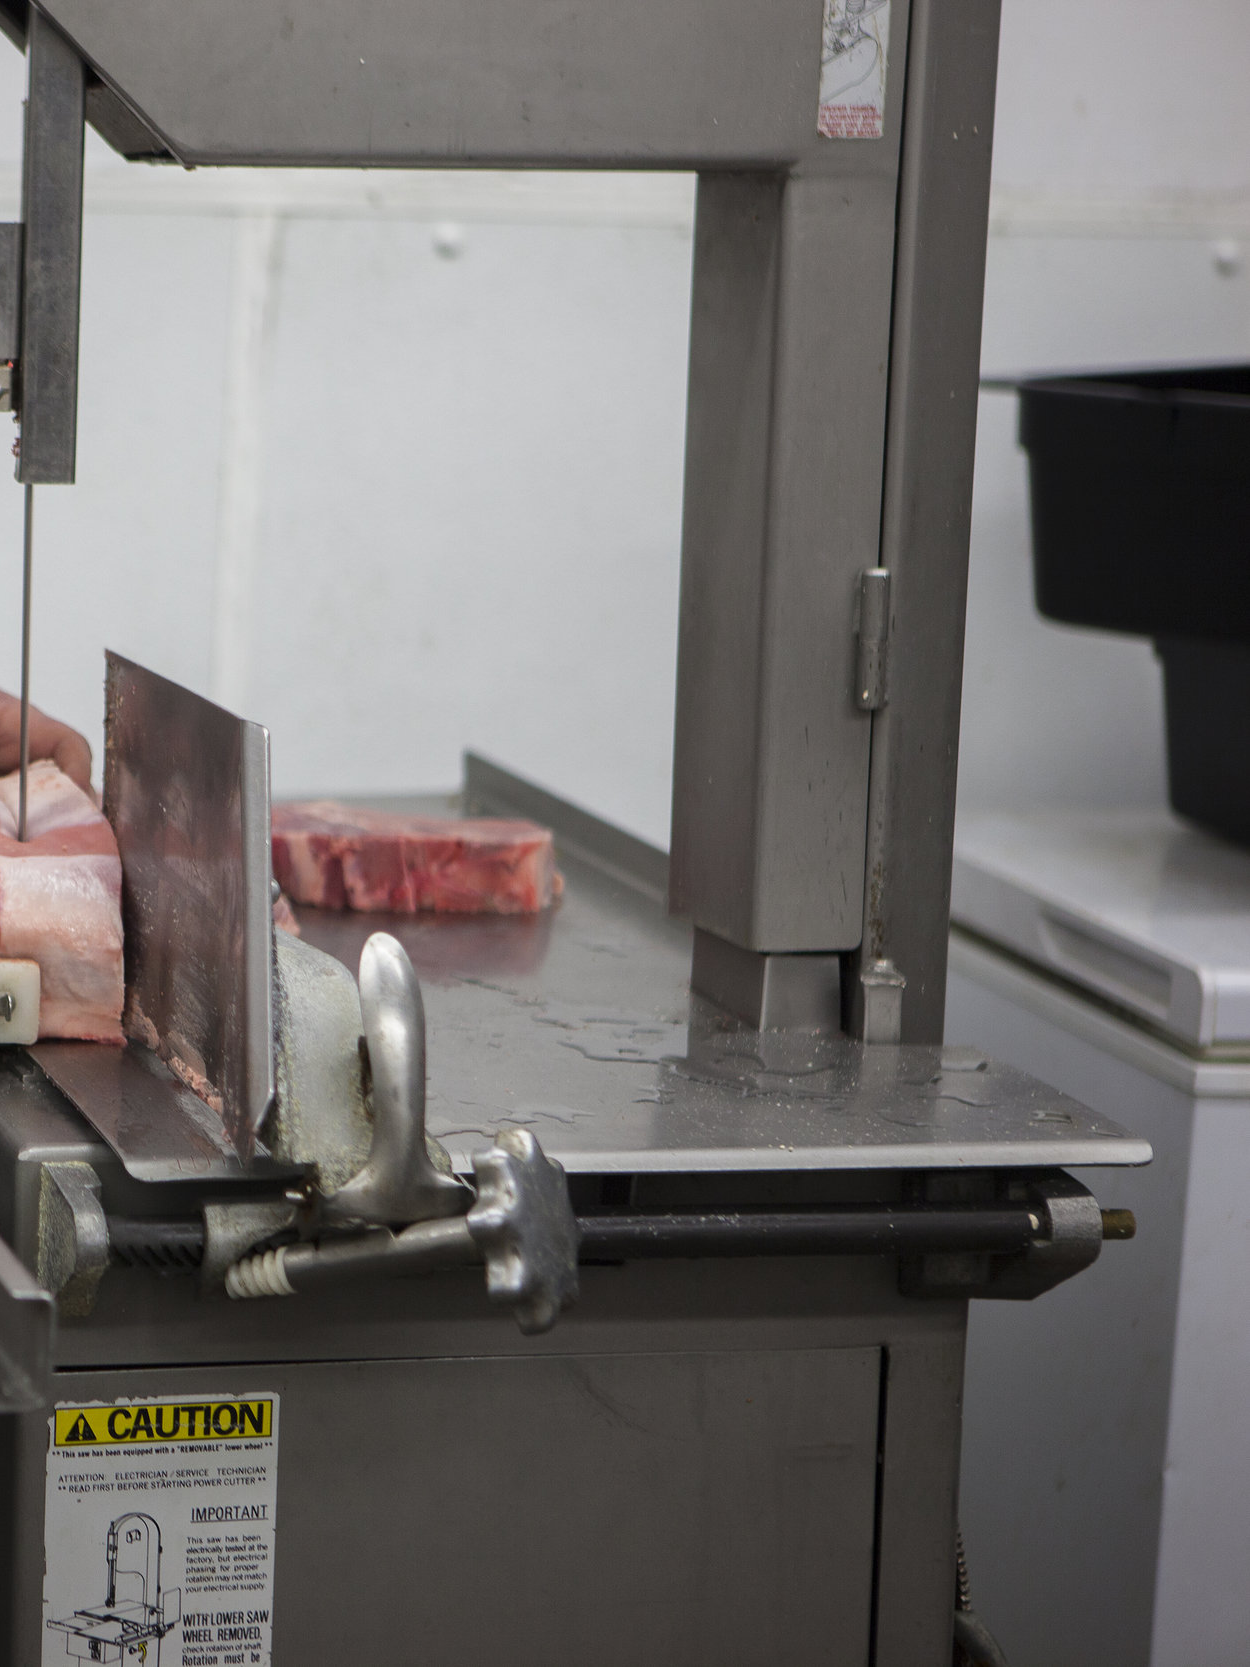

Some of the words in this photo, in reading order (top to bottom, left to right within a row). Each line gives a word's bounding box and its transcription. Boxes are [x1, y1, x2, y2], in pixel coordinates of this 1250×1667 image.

[108, 1403, 264, 1439] CAUTION
[62, 1450, 75, 1458] This
[105, 1448, 121, 1456] been
[123, 1447, 153, 1457] equipped
[155, 1446, 169, 1454] with
[245, 1442, 263, 1450] wheel
[115, 1470, 168, 1480] ELECTRICIAN
[175, 1468, 208, 1478] SERVICE
[216, 1466, 267, 1476] TECHNICIAN
[68, 1484, 90, 1493] READ
[92, 1483, 114, 1492] FIRST
[117, 1481, 147, 1491] BEFORE
[151, 1479, 191, 1489] STARTING
[193, 1478, 222, 1487] POWER
[223, 1477, 256, 1486] CUTTER
[191, 1504, 269, 1521] IMPORTANT
[187, 1536, 203, 1544] This
[225, 1535, 238, 1543] has
[242, 1534, 261, 1542] been
[186, 1545, 223, 1555] electrically
[257, 1543, 268, 1551] the
[233, 1553, 268, 1561] electrical
[185, 1566, 216, 1574] phasing
[220, 1564, 230, 1572] for
[234, 1564, 258, 1572] proper
[185, 1575, 213, 1584] rotation
[214, 1575, 230, 1583] may
[231, 1573, 243, 1581] not
[244, 1572, 268, 1580] match
[185, 1586, 201, 1595] your
[203, 1583, 239, 1592] electrical
[182, 1613, 208, 1627] WITH
[210, 1611, 244, 1626] LOWER
[246, 1610, 269, 1624] SAW
[182, 1629, 213, 1643] WHEEL
[217, 1626, 262, 1641] REMOVED,
[182, 1645, 204, 1654] check
[206, 1643, 234, 1652] rotation
[235, 1643, 242, 1651] of
[182, 1654, 218, 1667] Rotation
[224, 1652, 244, 1664] must
[251, 1651, 261, 1663] be
